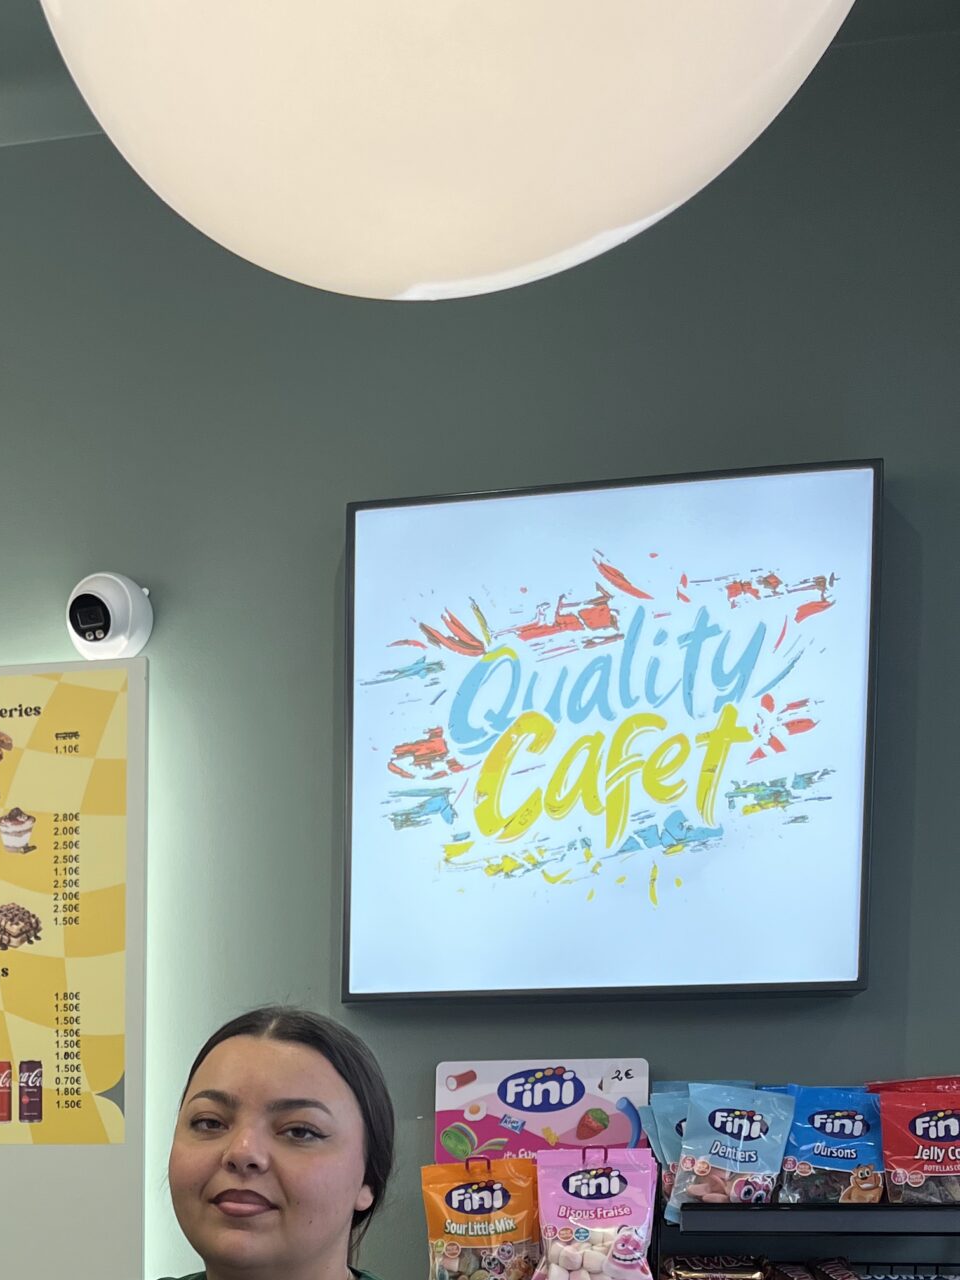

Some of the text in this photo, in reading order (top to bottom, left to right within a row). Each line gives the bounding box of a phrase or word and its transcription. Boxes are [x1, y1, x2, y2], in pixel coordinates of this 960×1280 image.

[448, 605, 767, 755] Quality
[54, 744, 79, 755] 1.10€
[473, 704, 752, 848] Cafet
[54, 813, 80, 823] 2.80€
[54, 827, 80, 836] 2.00€
[54, 841, 80, 850] 2.50€
[54, 855, 80, 864] 2.50€
[54, 867, 80, 876] 1.10€
[54, 879, 80, 889] 2.50€
[54, 892, 80, 901] 2.00€
[54, 904, 80, 913] 2.50€
[54, 916, 80, 926] 1.50€
[54, 992, 80, 1001] 1.80€
[55, 1004, 80, 1013] 1.50€
[55, 1017, 81, 1026] 1.50€
[55, 1029, 81, 1038] 1.50€
[55, 1040, 81, 1049] 1.50€
[55, 1064, 81, 1073] 1.50€
[55, 1076, 81, 1086] 0.70€
[56, 1087, 81, 1096] 1.80€
[506, 1071, 575, 1107] Fini
[56, 1100, 81, 1109] 1.50€
[713, 1111, 764, 1139] Fini
[814, 1114, 864, 1137] Fini
[915, 1117, 960, 1139] Fin
[711, 1141, 757, 1162] Dentiers
[814, 1143, 856, 1159] Oursons
[914, 1145, 941, 1163] Jelly
[569, 1170, 621, 1198] Fini
[452, 1183, 504, 1212] Fini
[559, 1205, 631, 1219] Bisous Fraise
[445, 1219, 516, 1236] Sour Little Mix
